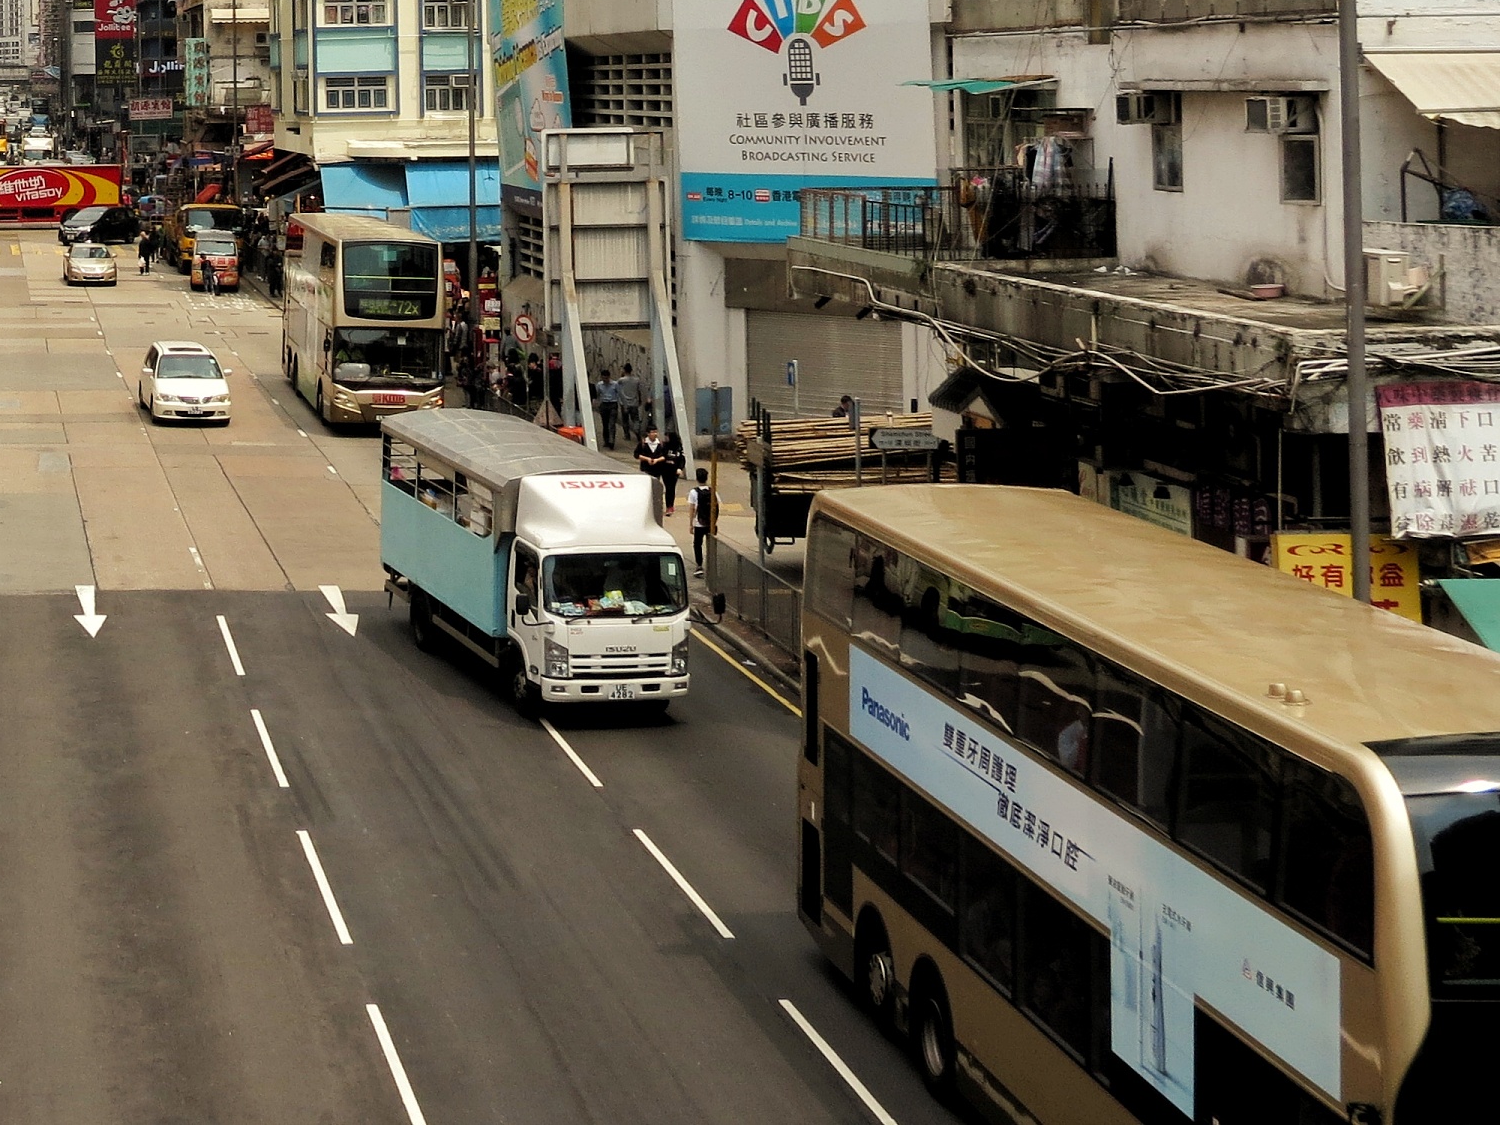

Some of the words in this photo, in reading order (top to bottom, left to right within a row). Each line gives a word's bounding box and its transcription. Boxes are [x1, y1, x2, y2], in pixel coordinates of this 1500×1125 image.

[97, 23, 131, 31] Jollibee
[735, 112, 874, 129] 社區參與廣播服務
[727, 189, 753, 201] 8-10
[560, 480, 625, 490] ISUZU
[1292, 562, 1405, 588] 好有益
[605, 645, 637, 653] ISUZU
[861, 685, 910, 741] Panasonic
[942, 722, 1018, 794] 雙重牙周護理
